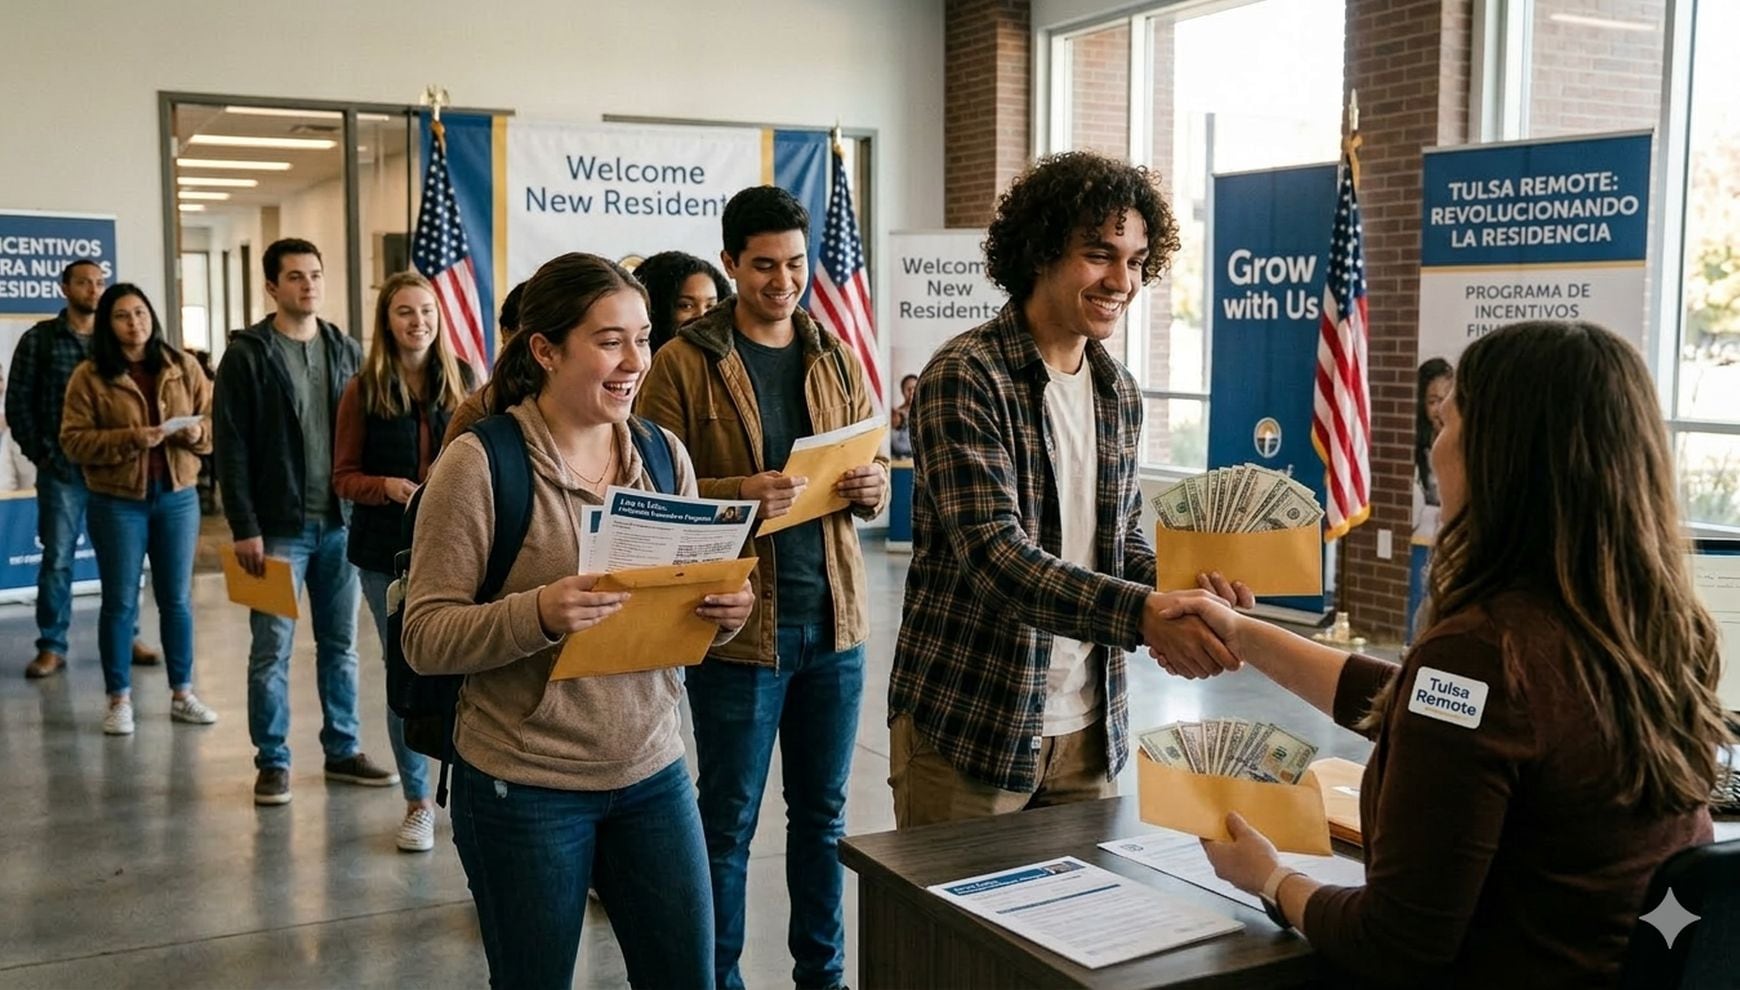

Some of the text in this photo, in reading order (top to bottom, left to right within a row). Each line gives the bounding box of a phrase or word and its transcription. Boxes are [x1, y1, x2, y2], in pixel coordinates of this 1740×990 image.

[566, 155, 705, 184] Welcome
[1448, 171, 1619, 201] TULSA REMOTE:
[526, 186, 727, 216] New Resident
[1430, 195, 1639, 225] REVOLUCIONANDO
[0, 236, 102, 257] CENTIVOS
[1451, 223, 1612, 248] LA RESIDENCIA
[902, 257, 984, 275] Welcom
[1227, 248, 1317, 286] Grow
[927, 280, 973, 297] New
[1465, 283, 1591, 300] PROGRAMA DE
[900, 300, 1001, 319] Residents
[1223, 289, 1319, 320] with Us
[1475, 303, 1580, 319] INCENTIVOS
[1430, 677, 1470, 699] Tulsa
[1416, 689, 1476, 716] Remote
